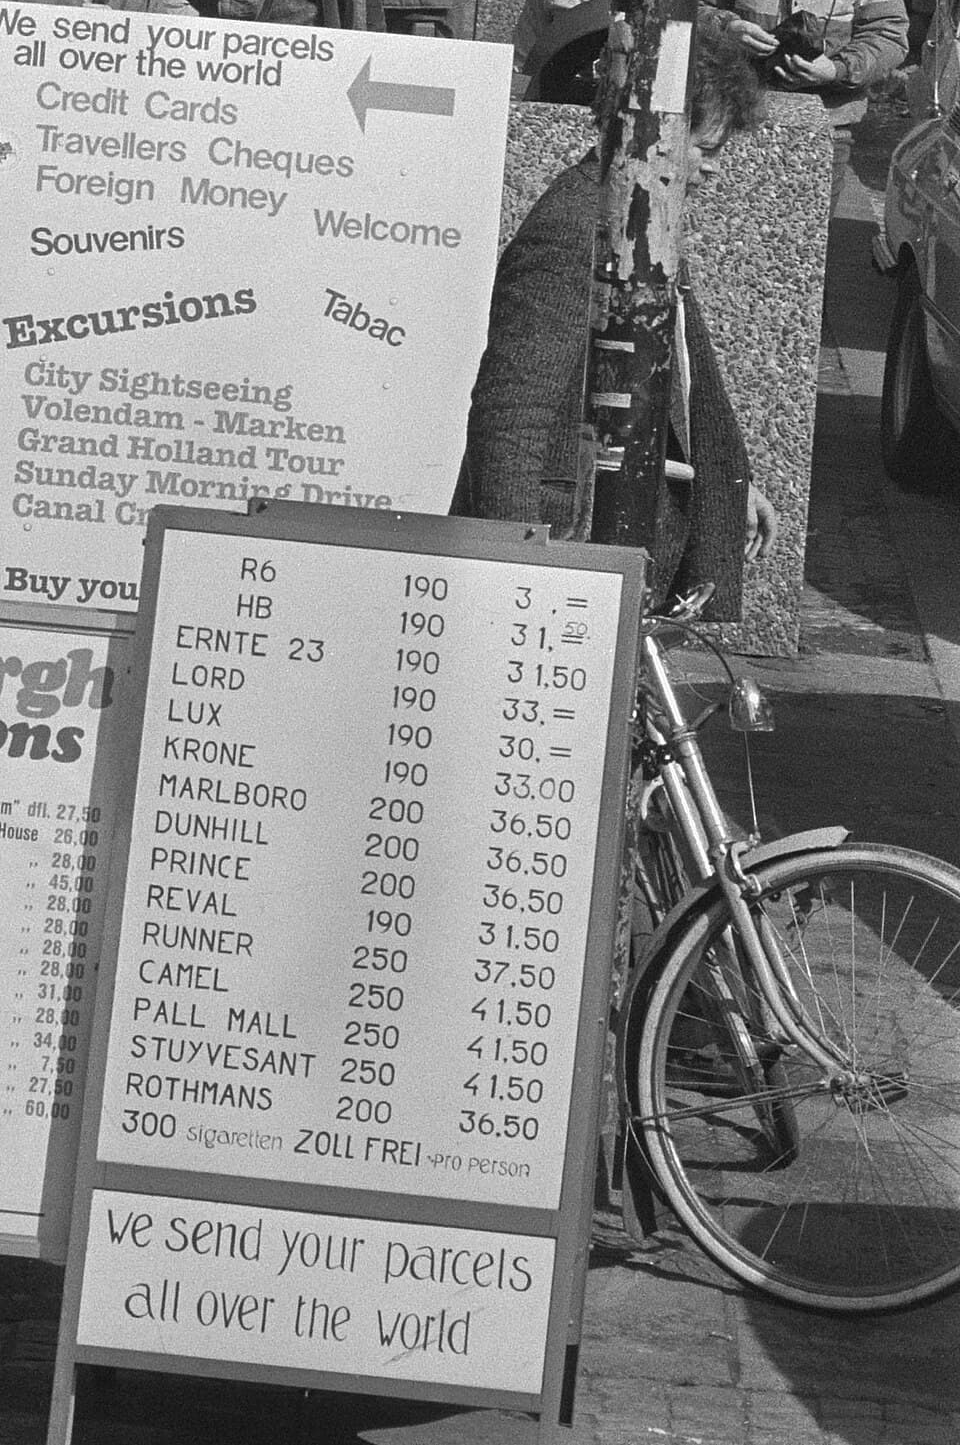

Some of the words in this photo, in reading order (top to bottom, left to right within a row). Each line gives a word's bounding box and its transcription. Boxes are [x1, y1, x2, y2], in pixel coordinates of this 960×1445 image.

[52, 17, 131, 45] send
[146, 24, 217, 52] your
[222, 33, 336, 63] parcels
[12, 39, 47, 68] all
[58, 47, 128, 74] over
[135, 48, 187, 80] the
[195, 58, 283, 88] world
[35, 80, 130, 117] Credit
[143, 89, 239, 126] Cards
[35, 123, 188, 163] Travellers
[207, 136, 355, 179] Cheques
[35, 164, 156, 206] Foreign
[179, 176, 289, 218] Money
[29, 224, 186, 257] Souvenirs
[312, 207, 463, 249] Welcome
[1, 287, 258, 350] Excursions
[323, 286, 407, 348] Tabac
[23, 358, 93, 396] City
[98, 367, 294, 413] Sightseeing
[20, 393, 186, 431] Volendam
[211, 409, 347, 445] Marken
[16, 426, 120, 459] Grand
[126, 435, 258, 470] Holland
[265, 446, 346, 477] Tour
[13, 458, 139, 498] Sunday
[11, 492, 107, 524] Canal
[3, 565, 72, 601] Buy
[239, 556, 278, 584] R6
[235, 592, 274, 620] HB
[175, 623, 269, 658] ERNTE
[287, 636, 325, 664] 23
[170, 661, 246, 692] LORD
[167, 697, 223, 728] LUX
[162, 734, 257, 769] KRONE
[158, 772, 308, 813] MARLBORO
[153, 809, 270, 847] DUNHILL
[149, 846, 252, 882] PRINCE
[146, 883, 238, 918] REVAL
[141, 920, 254, 958] RUNNER
[138, 958, 230, 994] CAMEL
[132, 996, 207, 1030] PALL
[226, 1006, 298, 1040] MALL
[129, 1033, 318, 1079] STUYVESANT
[125, 1071, 274, 1112] ROTHMANS
[120, 1108, 178, 1140] 300
[185, 1123, 284, 1151] sigaretten
[292, 1127, 355, 1161] ZOLL
[363, 1135, 422, 1168] FREI
[164, 1216, 263, 1262] send
[276, 1229, 366, 1277] your
[383, 1241, 533, 1293] parcels
[123, 1278, 181, 1324] all
[195, 1290, 276, 1334] over
[293, 1294, 352, 1343] the
[376, 1308, 472, 1357] world
